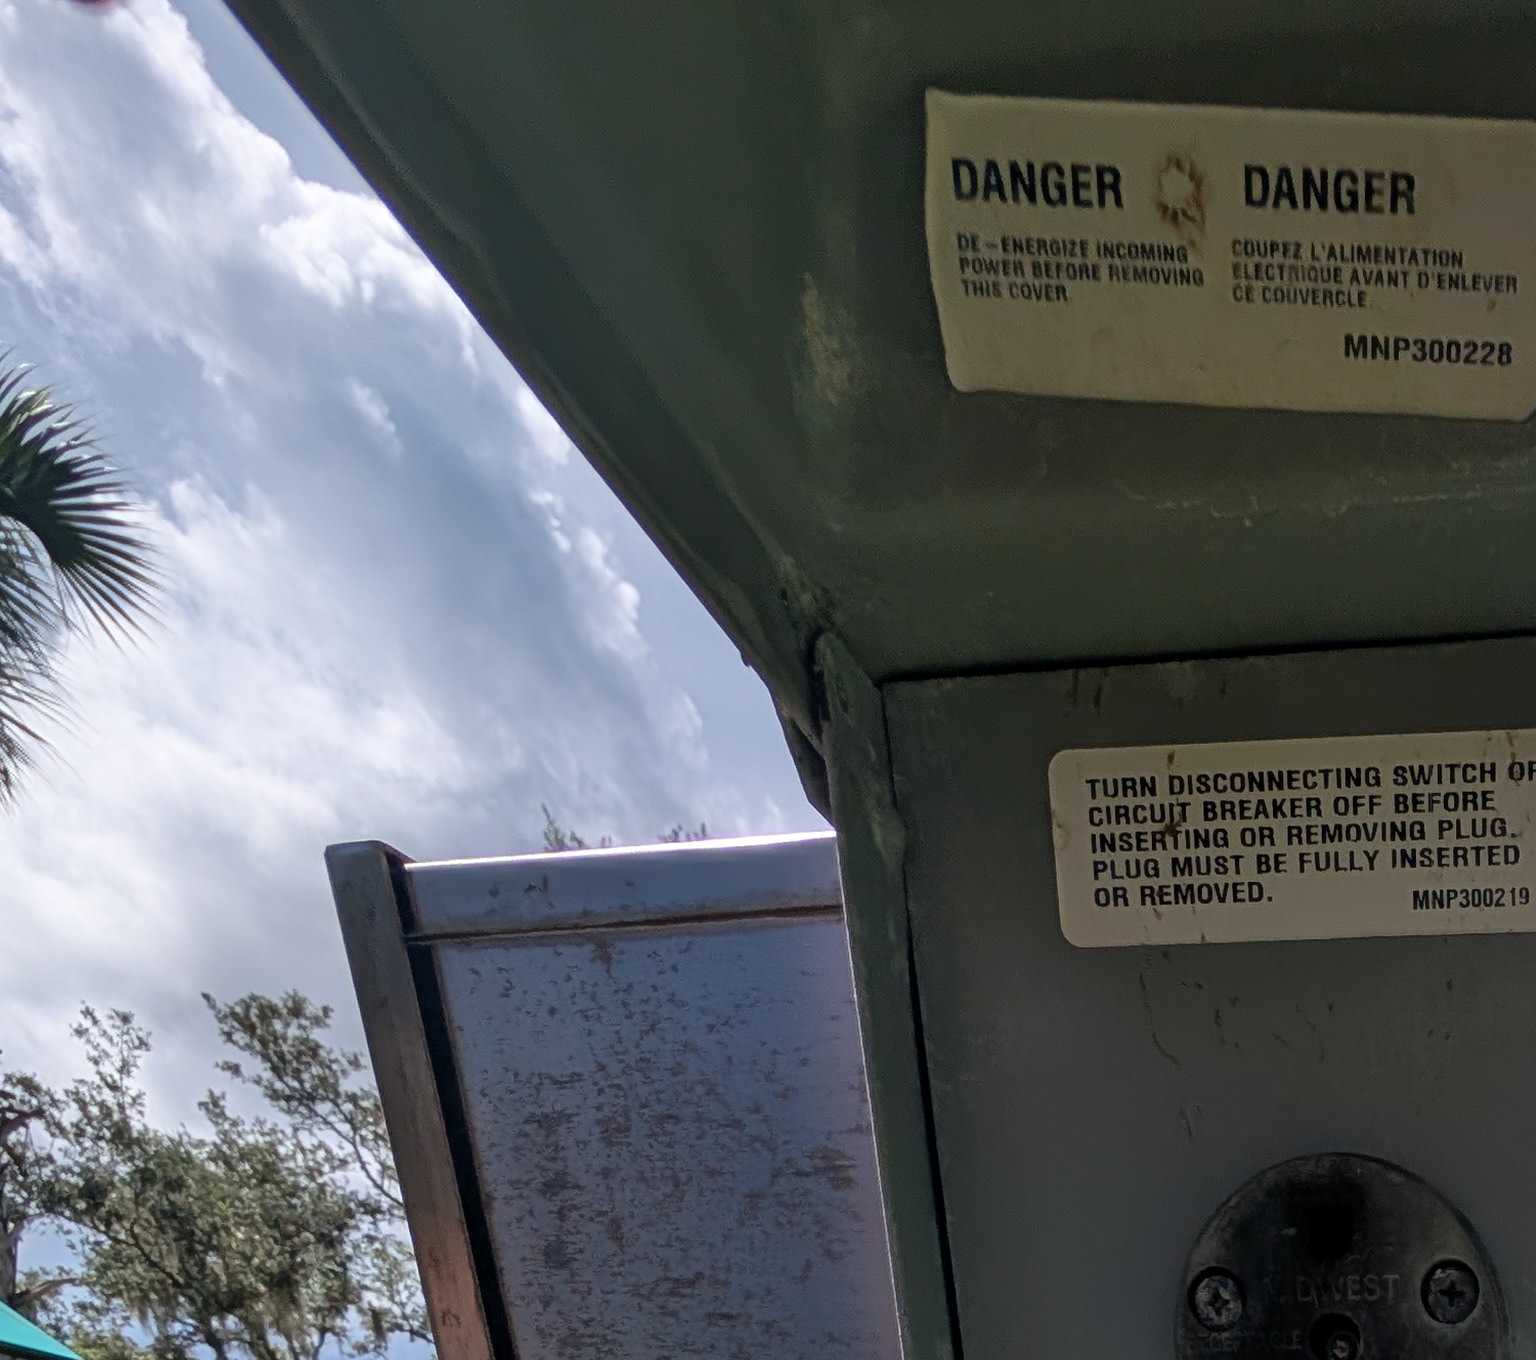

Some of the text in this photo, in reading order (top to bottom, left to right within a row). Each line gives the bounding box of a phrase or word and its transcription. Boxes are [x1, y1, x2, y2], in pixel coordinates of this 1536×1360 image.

[951, 157, 1124, 210] DANGER
[1244, 163, 1416, 216] DANGER
[1096, 239, 1188, 264] INCOMING
[1231, 239, 1464, 269] COUPEZ L'ALIMENTATION
[959, 257, 1205, 288] POWER BEFORE REMOVING
[960, 279, 1003, 298] THIS
[1349, 268, 1408, 289] AVANT
[1417, 271, 1518, 295] D'ENLEVER
[1232, 286, 1254, 305] CE
[1343, 334, 1514, 367] MNP300228
[1086, 776, 1157, 801] TURN
[1168, 767, 1382, 797] DISCONNECTING
[1392, 762, 1497, 786] SWITCH
[1088, 790, 1497, 827] CIRCUIT BREAKER OFF BEFORE
[1090, 828, 1230, 854] INSERTING
[1240, 826, 1276, 848] OR
[1287, 820, 1426, 847] REMOVING
[1092, 845, 1521, 881] PLUG MUST BE FULLY INSERTED
[1094, 881, 1531, 911] OR REMOVED. MNP300219
